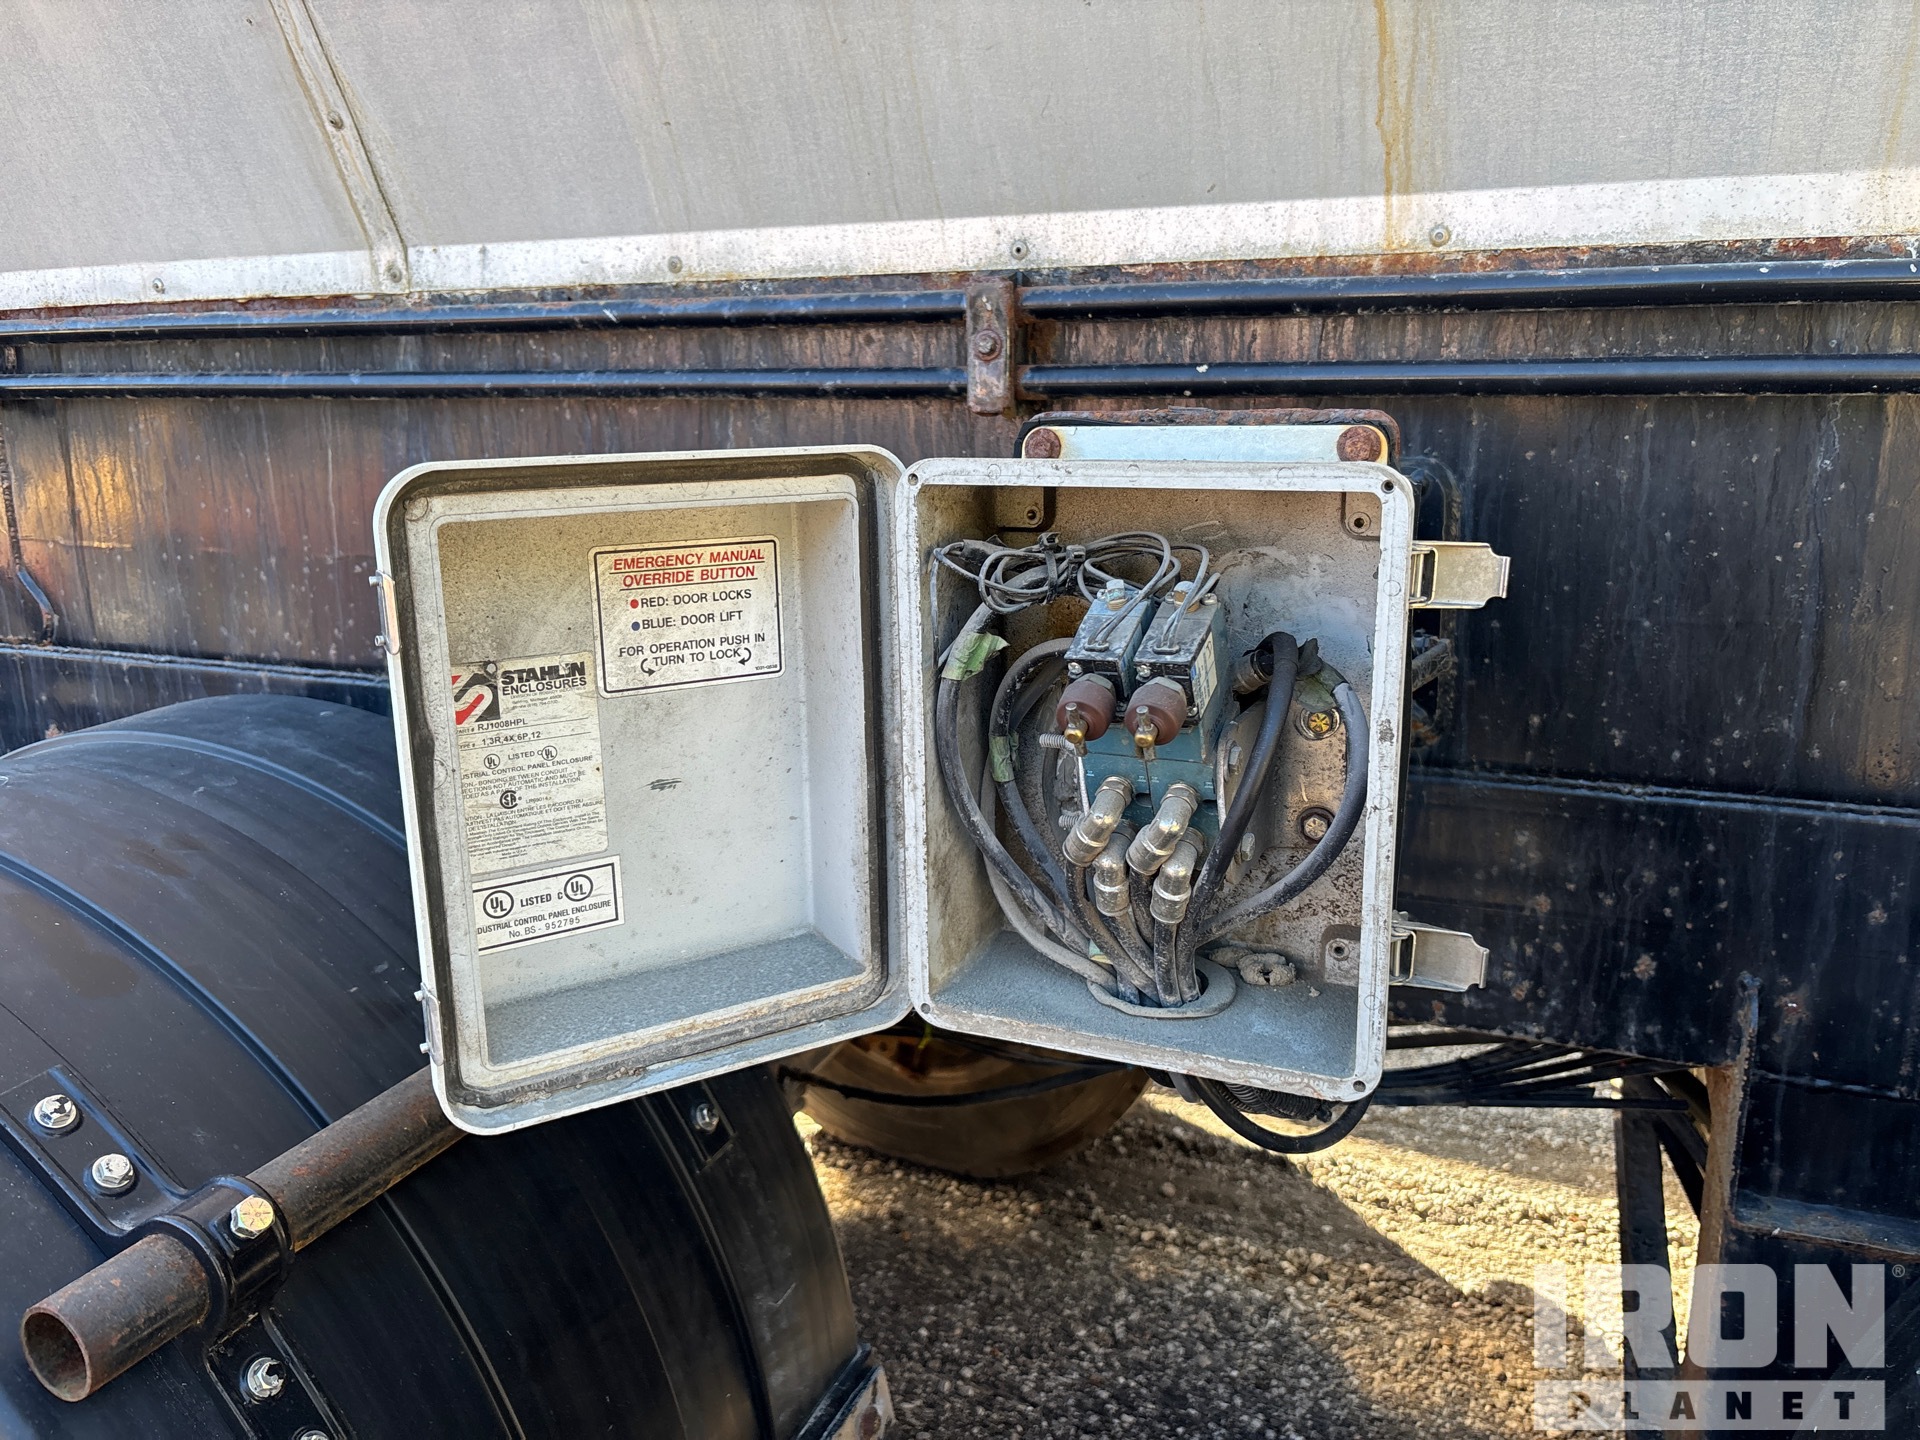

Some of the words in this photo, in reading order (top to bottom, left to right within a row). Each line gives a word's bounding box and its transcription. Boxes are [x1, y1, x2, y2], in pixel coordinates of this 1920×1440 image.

[614, 553, 703, 571] EMERGENCY
[709, 549, 764, 563] MANUAL
[623, 570, 694, 587] OVERRIDE
[700, 566, 755, 580] BUTTON
[641, 597, 669, 608] RED:
[674, 593, 708, 605] DOOR
[713, 589, 752, 602] LOCKS
[642, 618, 676, 630] BLUE:
[681, 614, 714, 626] DOOR
[720, 611, 743, 622] LIFT
[619, 646, 644, 658] FOR
[650, 638, 714, 654] OPERATION
[720, 633, 749, 646] PUSH
[755, 633, 765, 642] IN
[653, 654, 684, 666] TURN
[690, 652, 704, 662] TO
[710, 648, 740, 659] LOCK
[502, 677, 587, 696] ENCLOSURES
[478, 718, 528, 731] RJ1008HPL
[492, 766, 525, 775] CONTROL
[552, 755, 593, 766] ENCLOSURE
[508, 751, 535, 760] LISTED
[478, 776, 507, 786] BONDING
[509, 772, 539, 782] BETWEEN
[541, 767, 568, 777] CONDUIT
[508, 778, 544, 787] AUTOMATIC
[520, 894, 552, 907] LISTED
[478, 921, 512, 934] DUSTRIAL
[514, 915, 547, 926] CONTROL
[549, 908, 570, 920] PANEL
[572, 900, 611, 914] ENCLOSURE
[509, 929, 522, 938] No.
[545, 916, 581, 931] 952795
